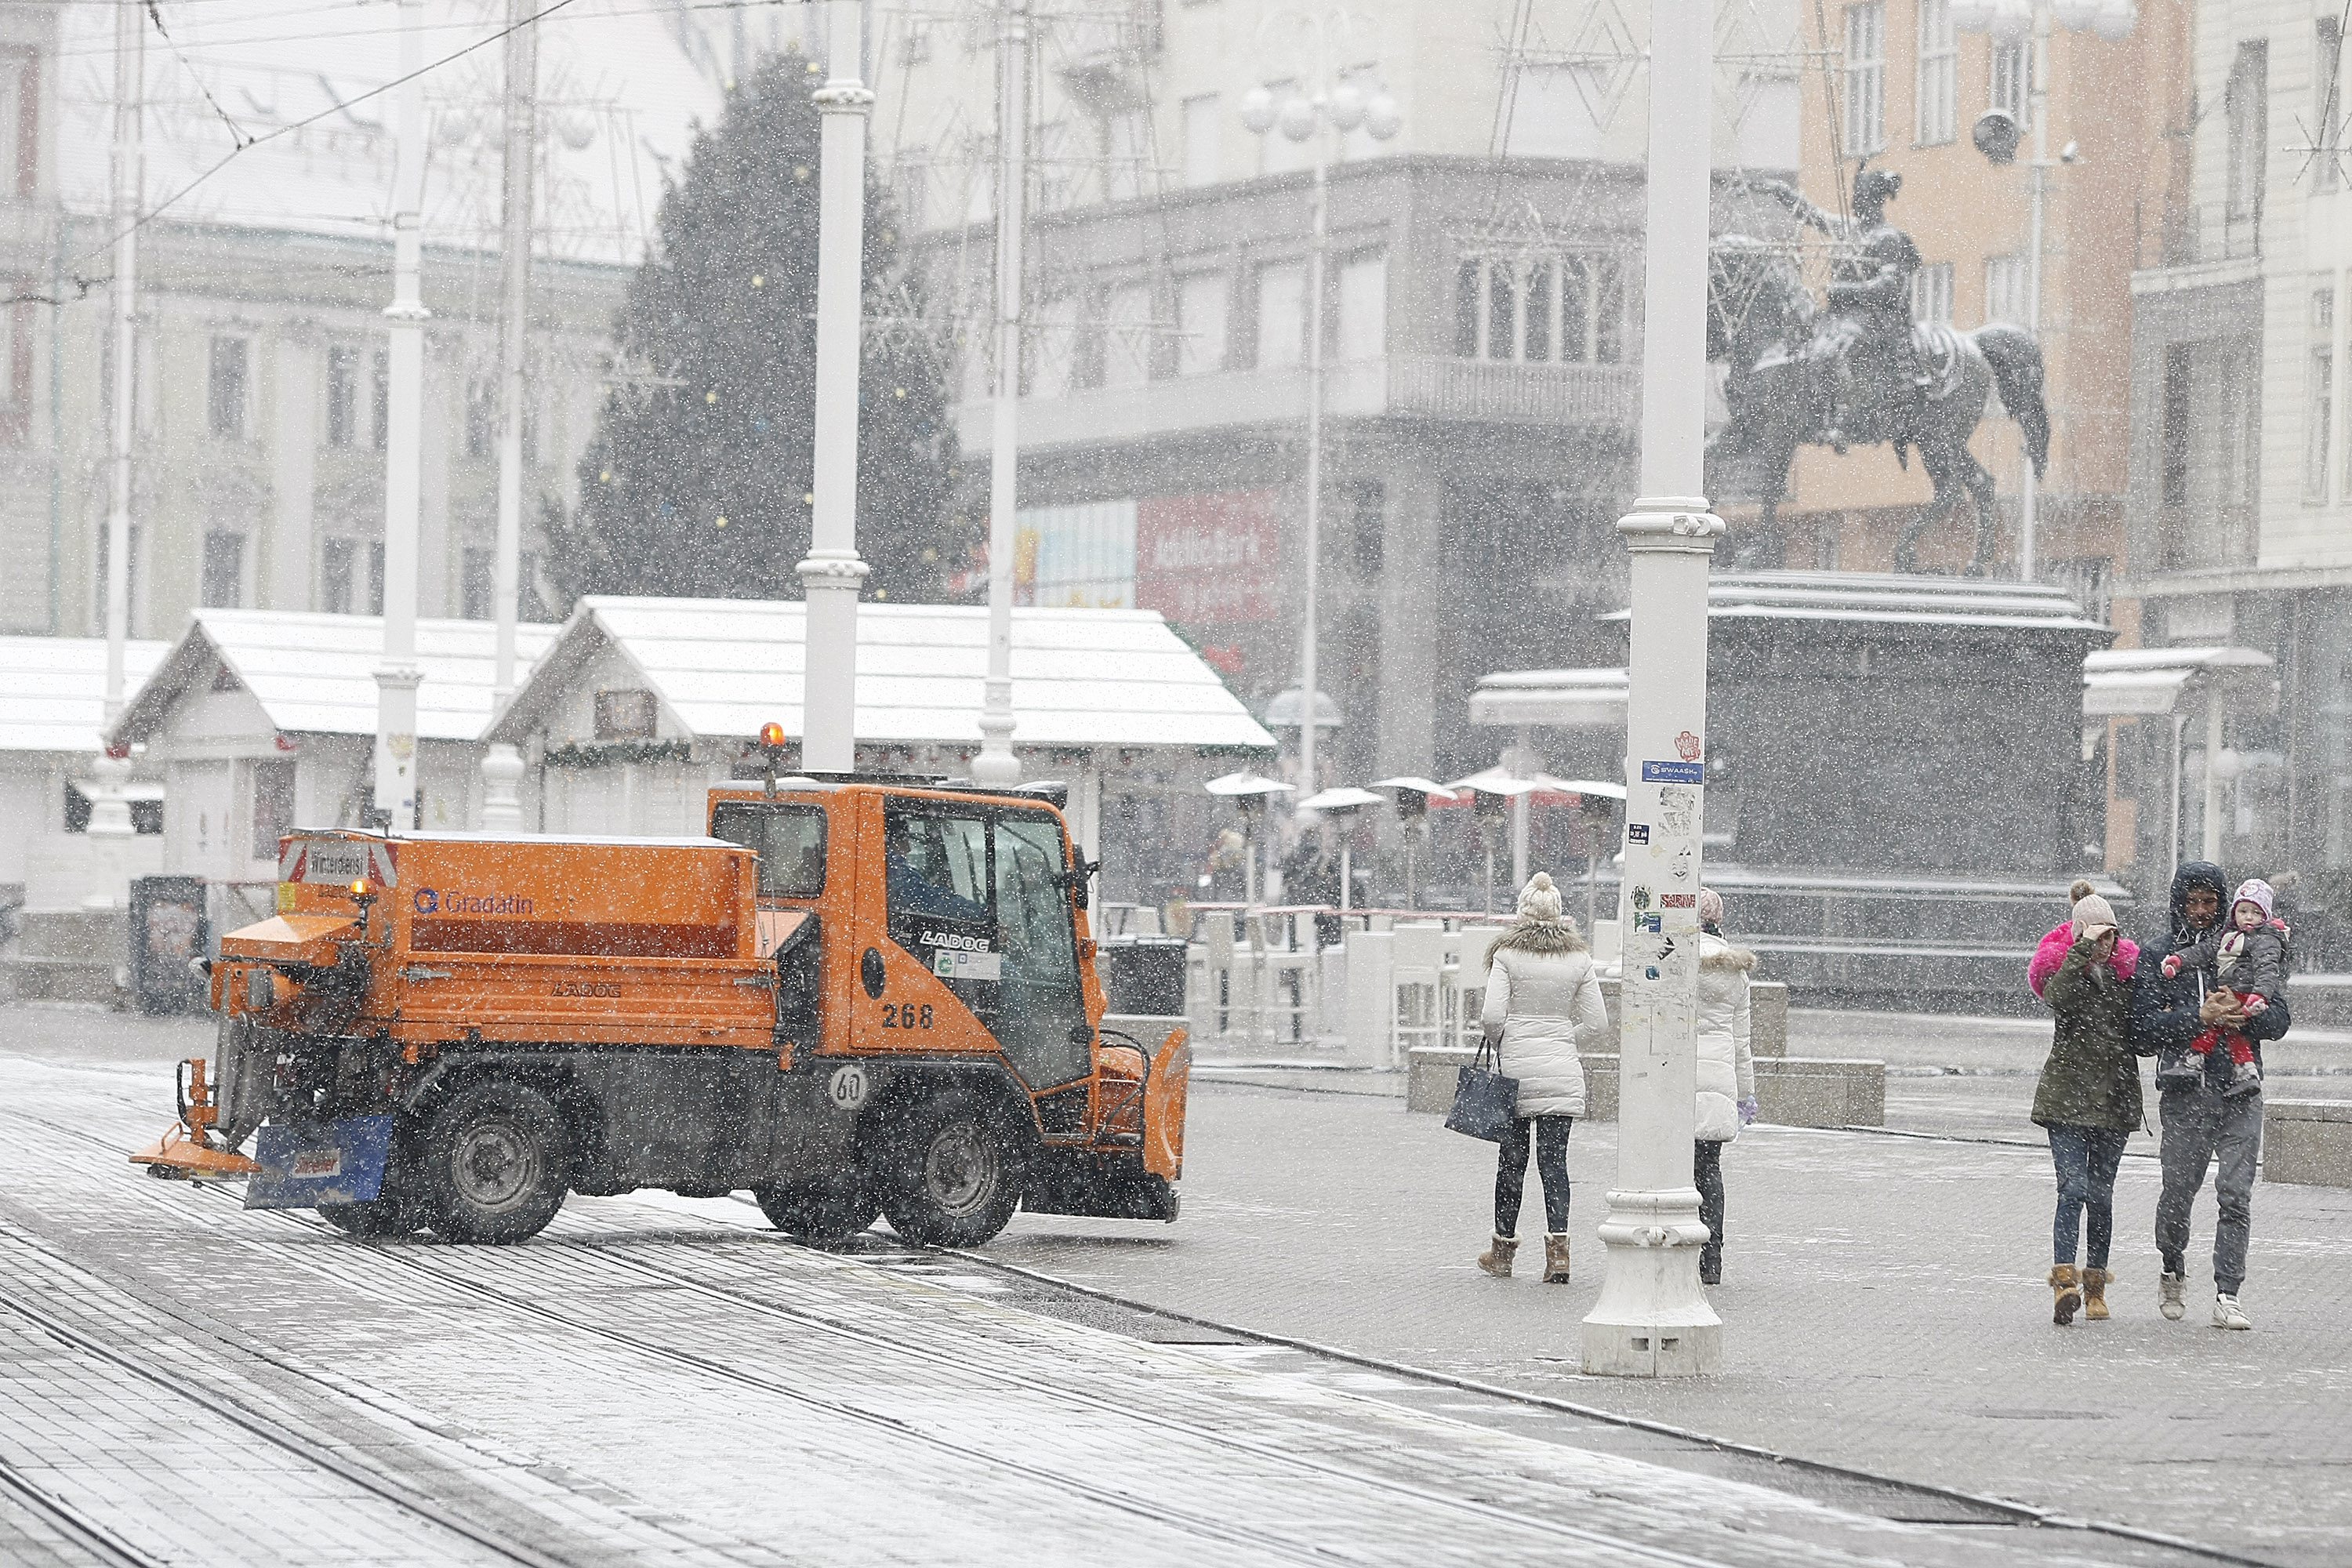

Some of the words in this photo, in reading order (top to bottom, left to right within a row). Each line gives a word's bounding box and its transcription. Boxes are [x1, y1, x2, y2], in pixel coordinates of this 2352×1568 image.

[311, 851, 364, 875] Winterdienst
[445, 892, 534, 914] Gradatin
[919, 931, 990, 953] LADOG
[551, 983, 622, 998] LADOG
[881, 1004, 934, 1029] 268
[837, 1073, 860, 1102] 60
